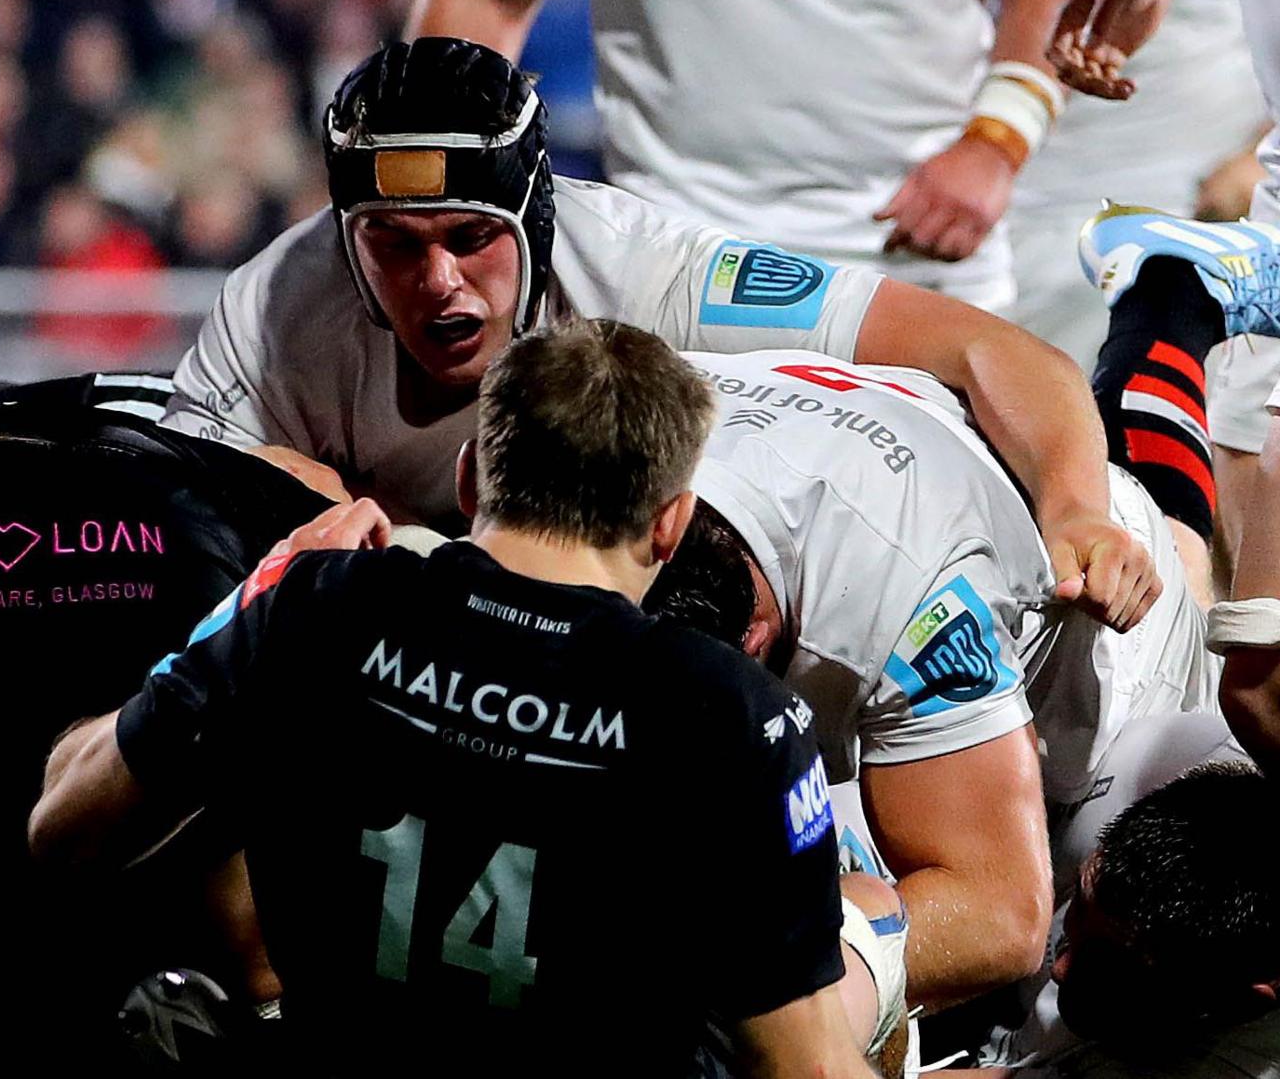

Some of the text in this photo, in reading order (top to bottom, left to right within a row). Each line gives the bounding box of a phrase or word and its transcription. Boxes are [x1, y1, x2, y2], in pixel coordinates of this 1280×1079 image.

[770, 392, 824, 413] of
[823, 407, 916, 475] Bank
[53, 520, 165, 555] LOAN
[51, 581, 155, 604] GLASGOW
[467, 593, 572, 635] WHATEVER IT TAKES
[360, 637, 627, 751] MALCOLM
[442, 728, 519, 760] GROUP
[360, 813, 538, 1010] 14
